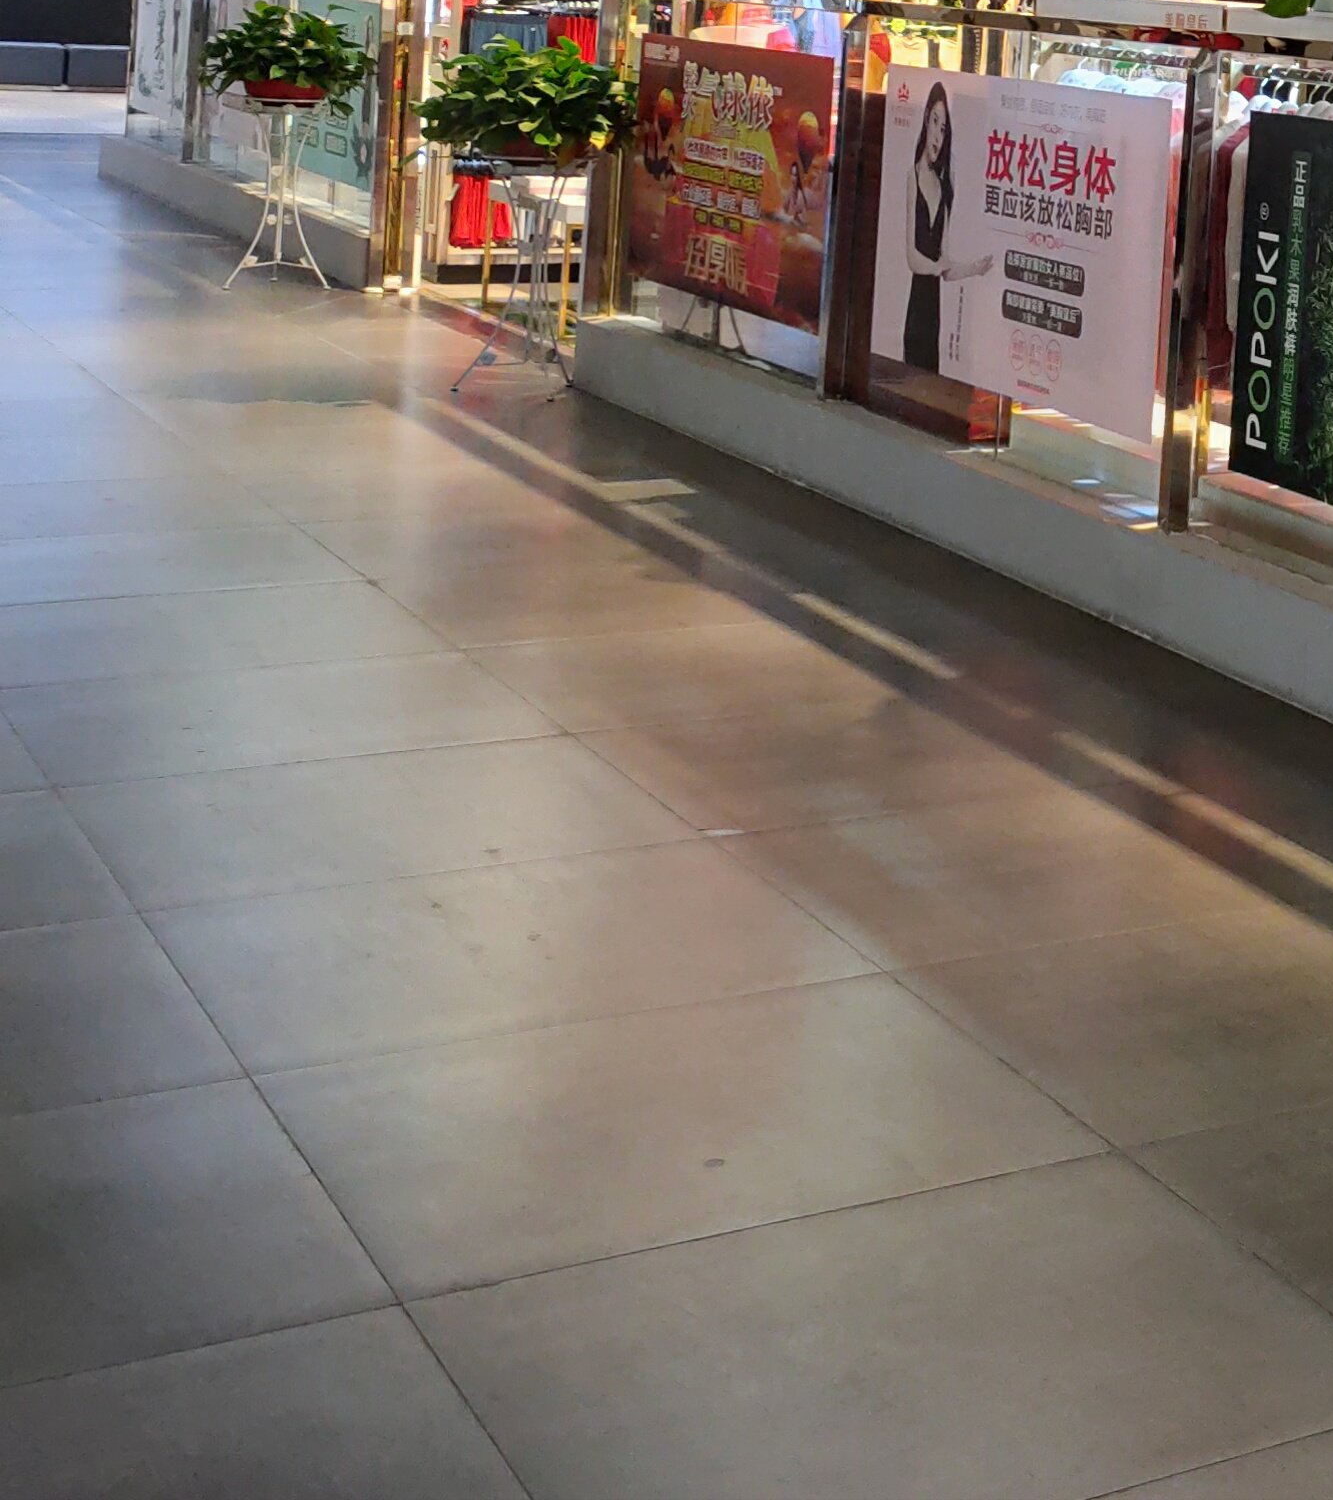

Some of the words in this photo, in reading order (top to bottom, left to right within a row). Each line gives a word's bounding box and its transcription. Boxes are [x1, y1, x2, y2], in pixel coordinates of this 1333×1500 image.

[984, 128, 1117, 203] 放松身体
[983, 183, 1113, 240] 更应该放松胸部
[1245, 231, 1280, 450] POPOKI
